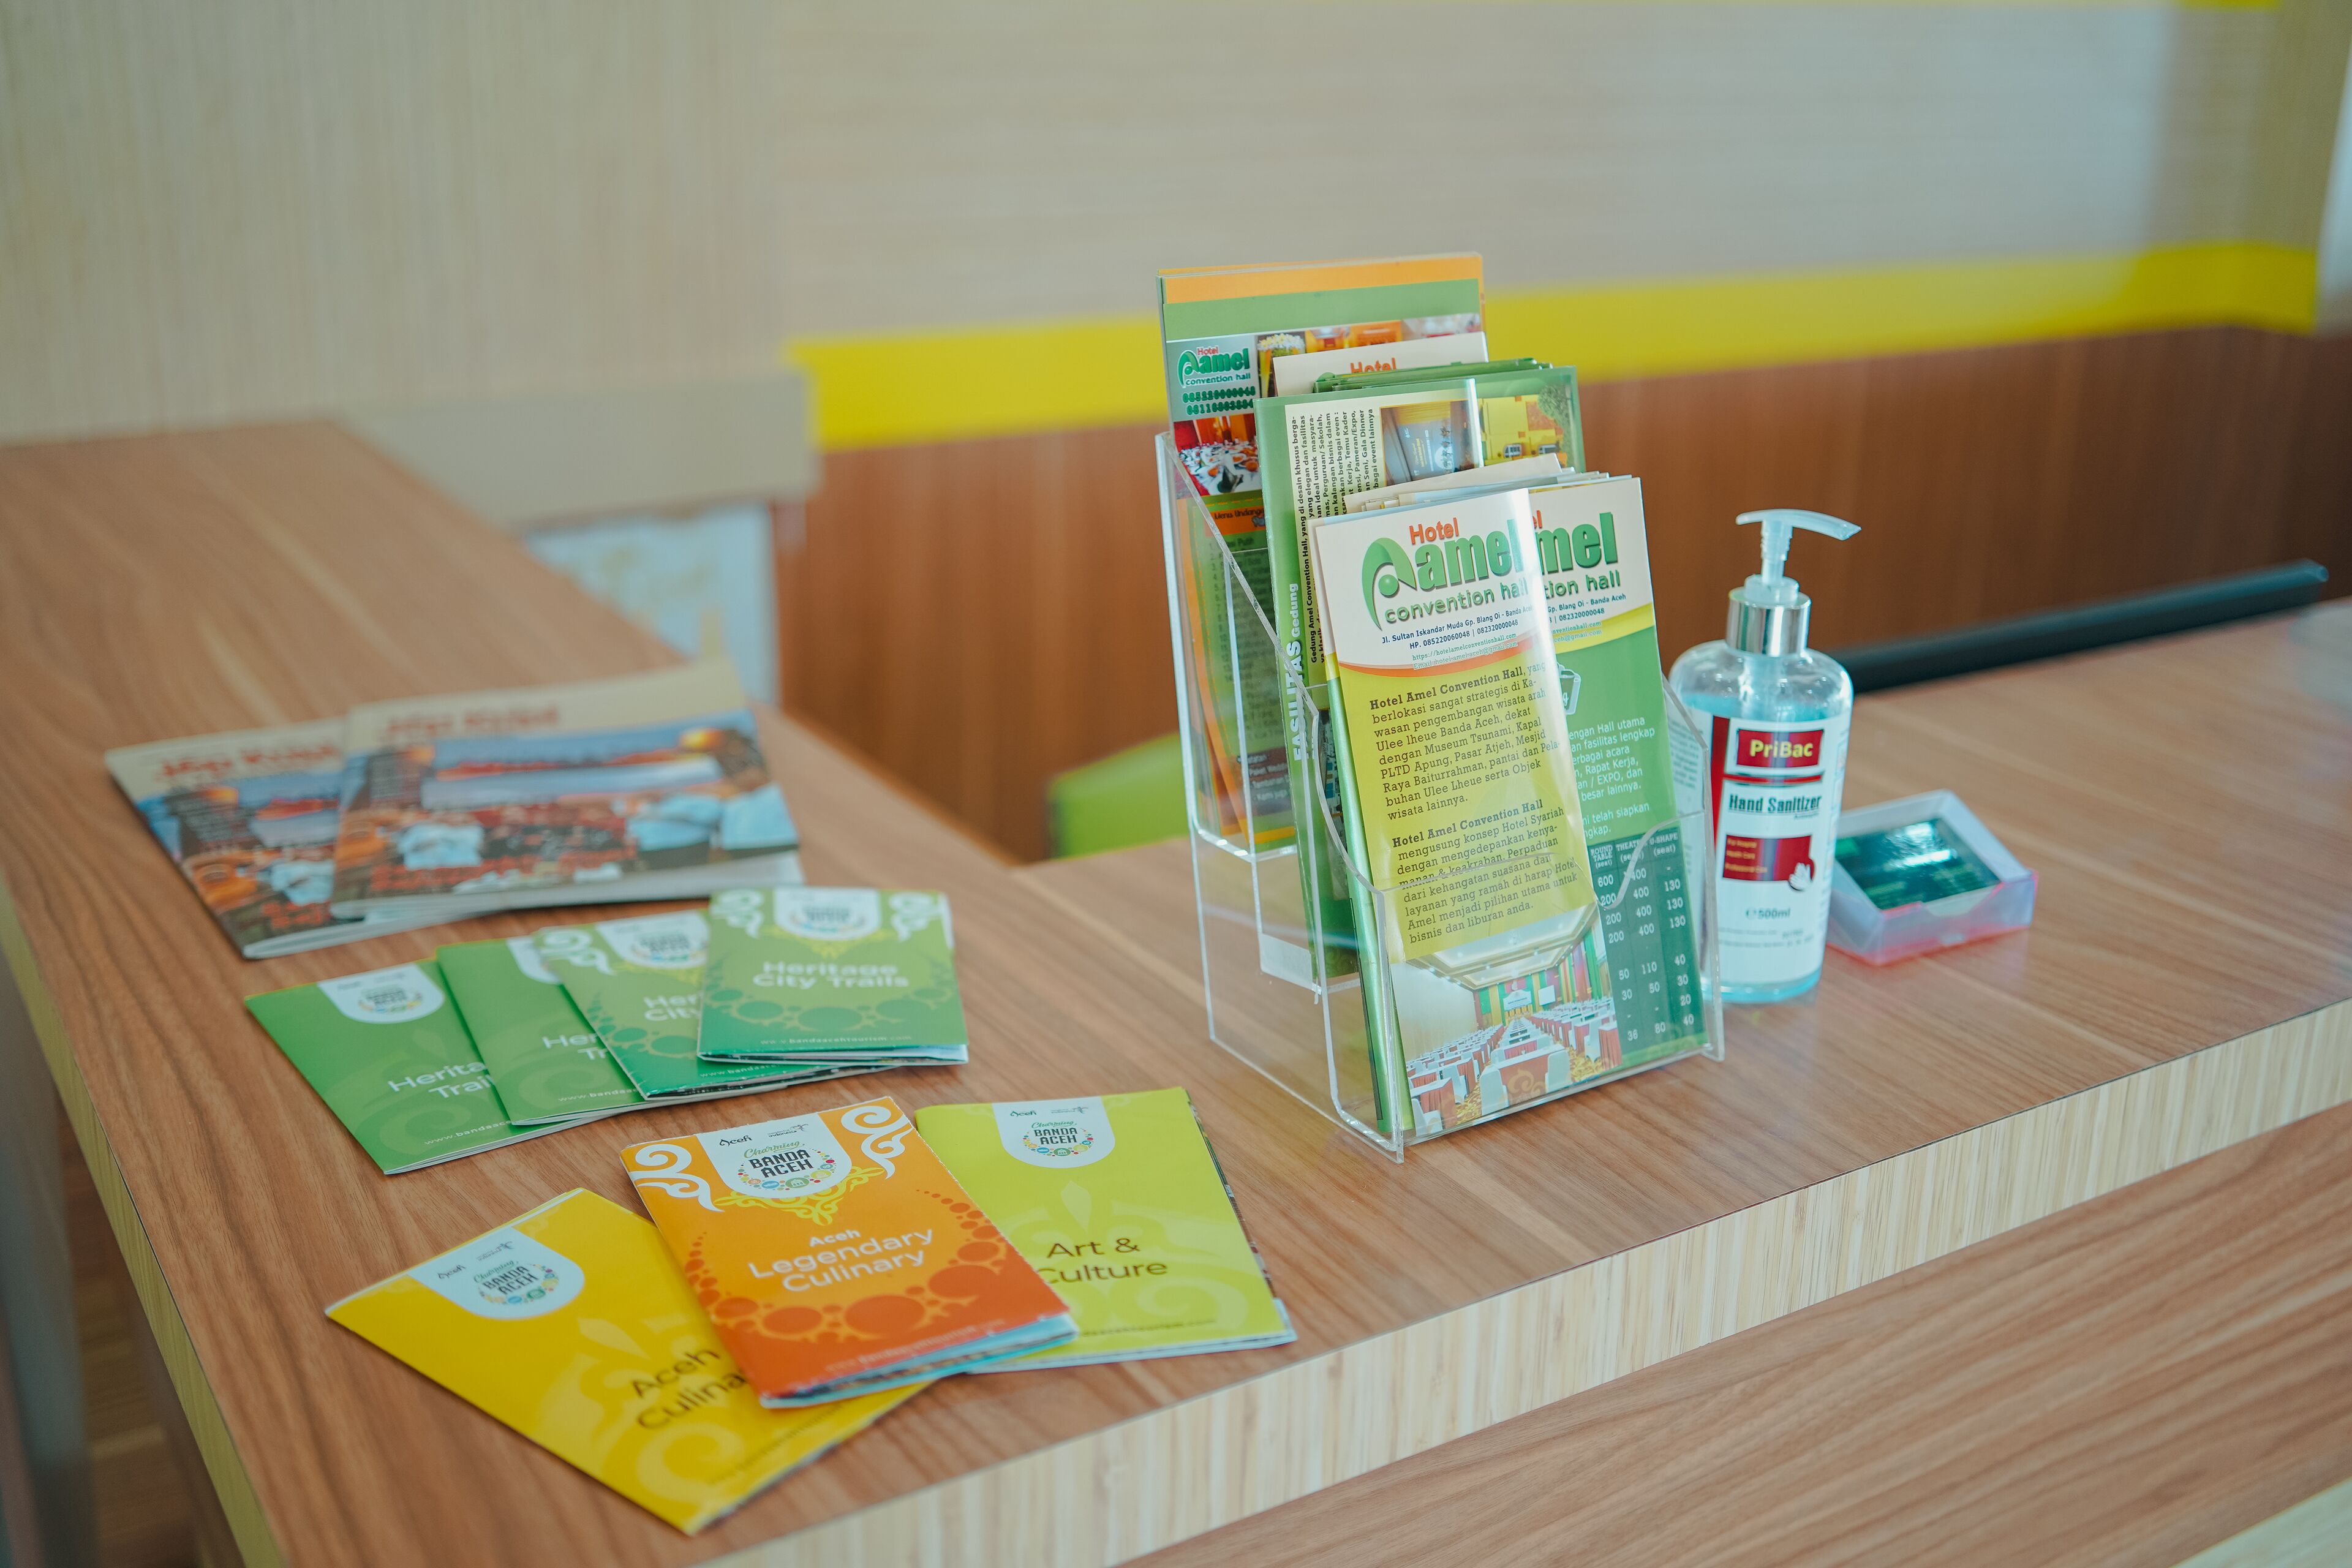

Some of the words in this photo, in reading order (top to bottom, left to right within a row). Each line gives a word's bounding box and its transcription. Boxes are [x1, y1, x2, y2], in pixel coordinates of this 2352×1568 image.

[1186, 375, 1232, 385] convention
[1329, 466, 1338, 503] kalangan
[1409, 518, 1459, 545] Hotel
[1303, 559, 1313, 605] Convention
[1586, 570, 1621, 592] hall
[1290, 583, 1300, 638] Gedung
[1384, 589, 1494, 623] convention
[1500, 578, 1528, 600] hall
[1559, 603, 1576, 612] Blang
[1591, 596, 1609, 605] Banda
[1611, 594, 1626, 602] Aceh
[1392, 631, 1414, 642] Sultan
[1416, 625, 1444, 637] Iskandar
[1447, 621, 1463, 630] Muda
[1477, 614, 1493, 625] Blang
[1506, 608, 1521, 617] Banda
[1559, 608, 1605, 621] 082320000048
[1423, 631, 1470, 647] 085220060048
[1477, 619, 1518, 635] 082320000048
[1370, 695, 1403, 710] Hotel
[1406, 687, 1436, 703] Amel
[1440, 674, 1500, 695] Convention
[1502, 667, 1526, 684] Hall,
[1528, 663, 1545, 676] yang
[1373, 706, 1426, 723] berlokasi
[1430, 696, 1464, 712] sangat
[1467, 685, 1509, 702] strategis
[1374, 723, 1409, 737] wasan
[1413, 704, 1493, 731] pengembangan
[1497, 695, 1525, 709] wisata
[1528, 688, 1545, 701] arah
[1376, 738, 1403, 752] Ulee
[1441, 723, 1472, 737] Banda
[1475, 715, 1502, 728] Aceh,
[1506, 708, 1531, 722] dekat
[1597, 722, 1614, 734] Hall
[1618, 717, 1645, 729] utama
[1379, 749, 1422, 766] dengan
[1425, 738, 1468, 755] Museum
[1471, 726, 1514, 744] Tsunami,
[1517, 717, 1541, 731] Kapal
[1584, 735, 1618, 750] fasilitas
[1620, 727, 1655, 742] lengkap
[1750, 739, 1813, 758] PriBac
[1381, 764, 1410, 778] PLTD
[1414, 756, 1452, 772] Apung,
[1455, 749, 1482, 761] Pasar
[1485, 739, 1513, 754] Atjeh,
[1517, 730, 1545, 745] Mesjid
[1607, 745, 1630, 758] acara
[1384, 781, 1411, 793] Raya
[1414, 763, 1487, 786] Baiturrahman,
[1489, 753, 1519, 767] pantai
[1523, 747, 1539, 758] dan
[1586, 762, 1610, 775] Rapat
[1613, 756, 1638, 770] Kerja,
[1597, 771, 1623, 785] EXPO,
[1627, 767, 1643, 778] dan
[1385, 791, 1421, 807] buhan
[1424, 785, 1448, 798] Ulee
[1451, 778, 1482, 791] Lheue
[1485, 770, 1509, 781] serta
[1513, 759, 1541, 774] Objek
[1582, 788, 1605, 801] besar
[1608, 782, 1642, 794] lainnya.
[1388, 806, 1423, 820] wisata
[1427, 797, 1468, 811] lainnya.
[1593, 811, 1613, 824] telah
[1616, 803, 1649, 819] siapkan
[1729, 794, 1763, 813] Hand
[1768, 796, 1822, 813] Sanitizer
[1392, 832, 1424, 848] Hotel
[1428, 824, 1457, 839] Amel
[1460, 809, 1519, 829] Convention
[1521, 799, 1543, 813] Hall
[1398, 839, 1461, 862] mengusung
[1464, 827, 1499, 843] konsep
[1502, 819, 1528, 832] Hotel
[1531, 807, 1564, 824] Syariah
[1397, 858, 1438, 875] dengan
[1441, 835, 1525, 863] mengedepankan
[1507, 839, 1558, 858] Perpaduan
[1654, 844, 1676, 856] (seat)
[1404, 891, 1426, 903] dari
[1430, 873, 1489, 896] kehangatan
[1493, 862, 1530, 878] suasana
[1406, 899, 1447, 917] layanan
[1451, 891, 1476, 906] yang
[1479, 881, 1509, 896] ramah
[1525, 868, 1552, 884] harap
[1598, 875, 1613, 887] 600
[1665, 879, 1680, 892] 130
[1408, 917, 1436, 930] Amel
[1439, 901, 1482, 921] menjadi
[1484, 892, 1519, 911] pilihan
[1521, 884, 1550, 898] utama
[1553, 872, 1577, 888] untuk
[1634, 886, 1649, 899] 400
[1667, 897, 1683, 910] 130
[1409, 928, 1442, 943] bisnis
[1468, 911, 1504, 928] liburan
[1606, 913, 1621, 925] 200
[1636, 905, 1652, 918] 400
[1670, 916, 1686, 929] 130
[1608, 931, 1624, 943] 200
[1639, 924, 1654, 936] 400
[763, 961, 898, 976] Heritage
[1642, 962, 1657, 974] 110
[753, 974, 816, 989] City
[827, 974, 910, 989] Trails
[388, 1061, 489, 1092] Herita
[720, 1135, 752, 1147] Aceh
[1034, 1128, 1077, 1137] BANDA
[1040, 1135, 1077, 1145] ACEH
[744, 1141, 800, 1158] Charming
[748, 1149, 810, 1169] BANDA
[761, 1159, 813, 1178] ACEH
[810, 1229, 861, 1247] Aceh
[1047, 1241, 1105, 1258] Art
[1115, 1238, 1140, 1253] &
[748, 1229, 932, 1279] Legendary
[482, 1265, 529, 1289] BANDA
[782, 1250, 924, 1292] Culinary
[1038, 1262, 1167, 1284] Culture
[498, 1273, 540, 1295] ACEH
[632, 1350, 720, 1398] Aceh
[636, 1373, 747, 1430] Culina
